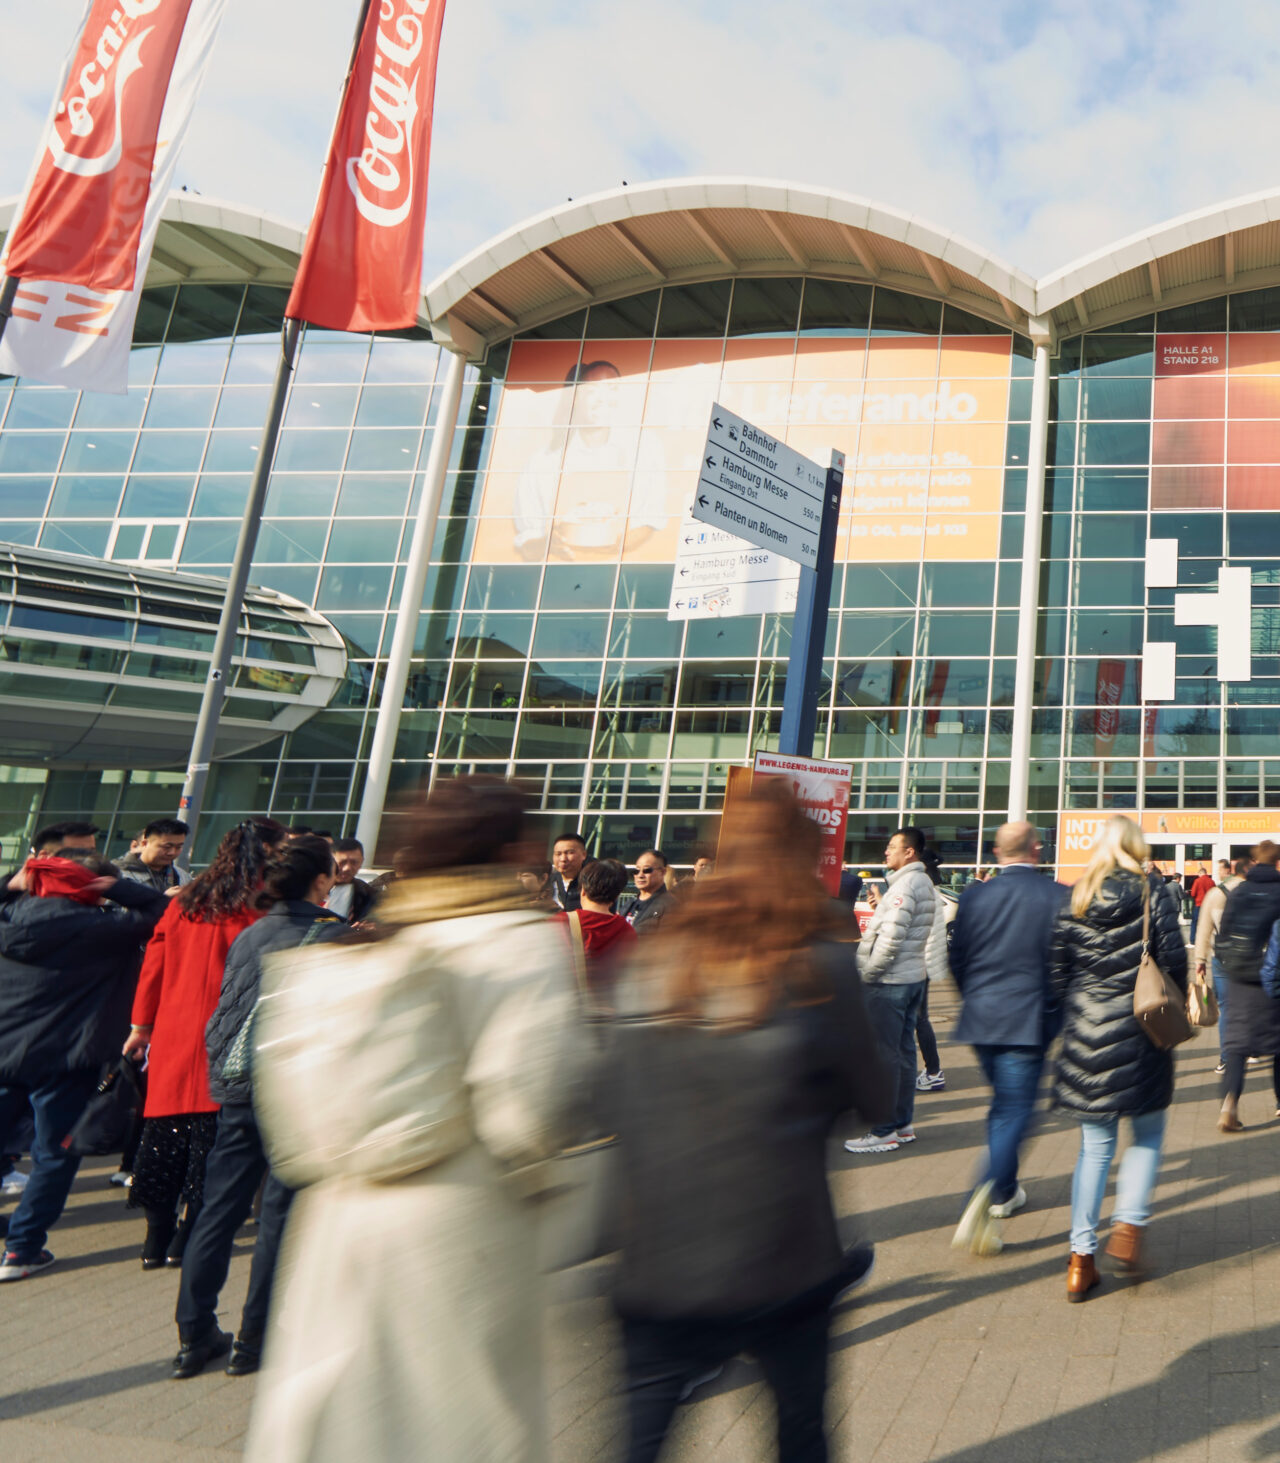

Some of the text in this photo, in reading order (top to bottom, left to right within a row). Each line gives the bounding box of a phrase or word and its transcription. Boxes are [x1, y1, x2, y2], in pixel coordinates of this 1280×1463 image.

[48, 0, 161, 176] Coca-
[347, 0, 430, 227] Coca-C
[1163, 346, 1213, 354] HALLE A1
[1163, 355, 1219, 365] STAND 218
[743, 381, 978, 421] Lieferando
[742, 425, 777, 454] Bahnhof
[739, 440, 778, 471] Dammtor
[720, 473, 758, 500] Eingang Ost
[722, 456, 788, 500] Hamburg Messe
[714, 500, 788, 544] Planten un Blomen
[803, 507, 814, 518] 550
[693, 554, 769, 570] Hamburg Messe
[802, 543, 810, 554] 50
[1176, 815, 1271, 830] Willkommen!
